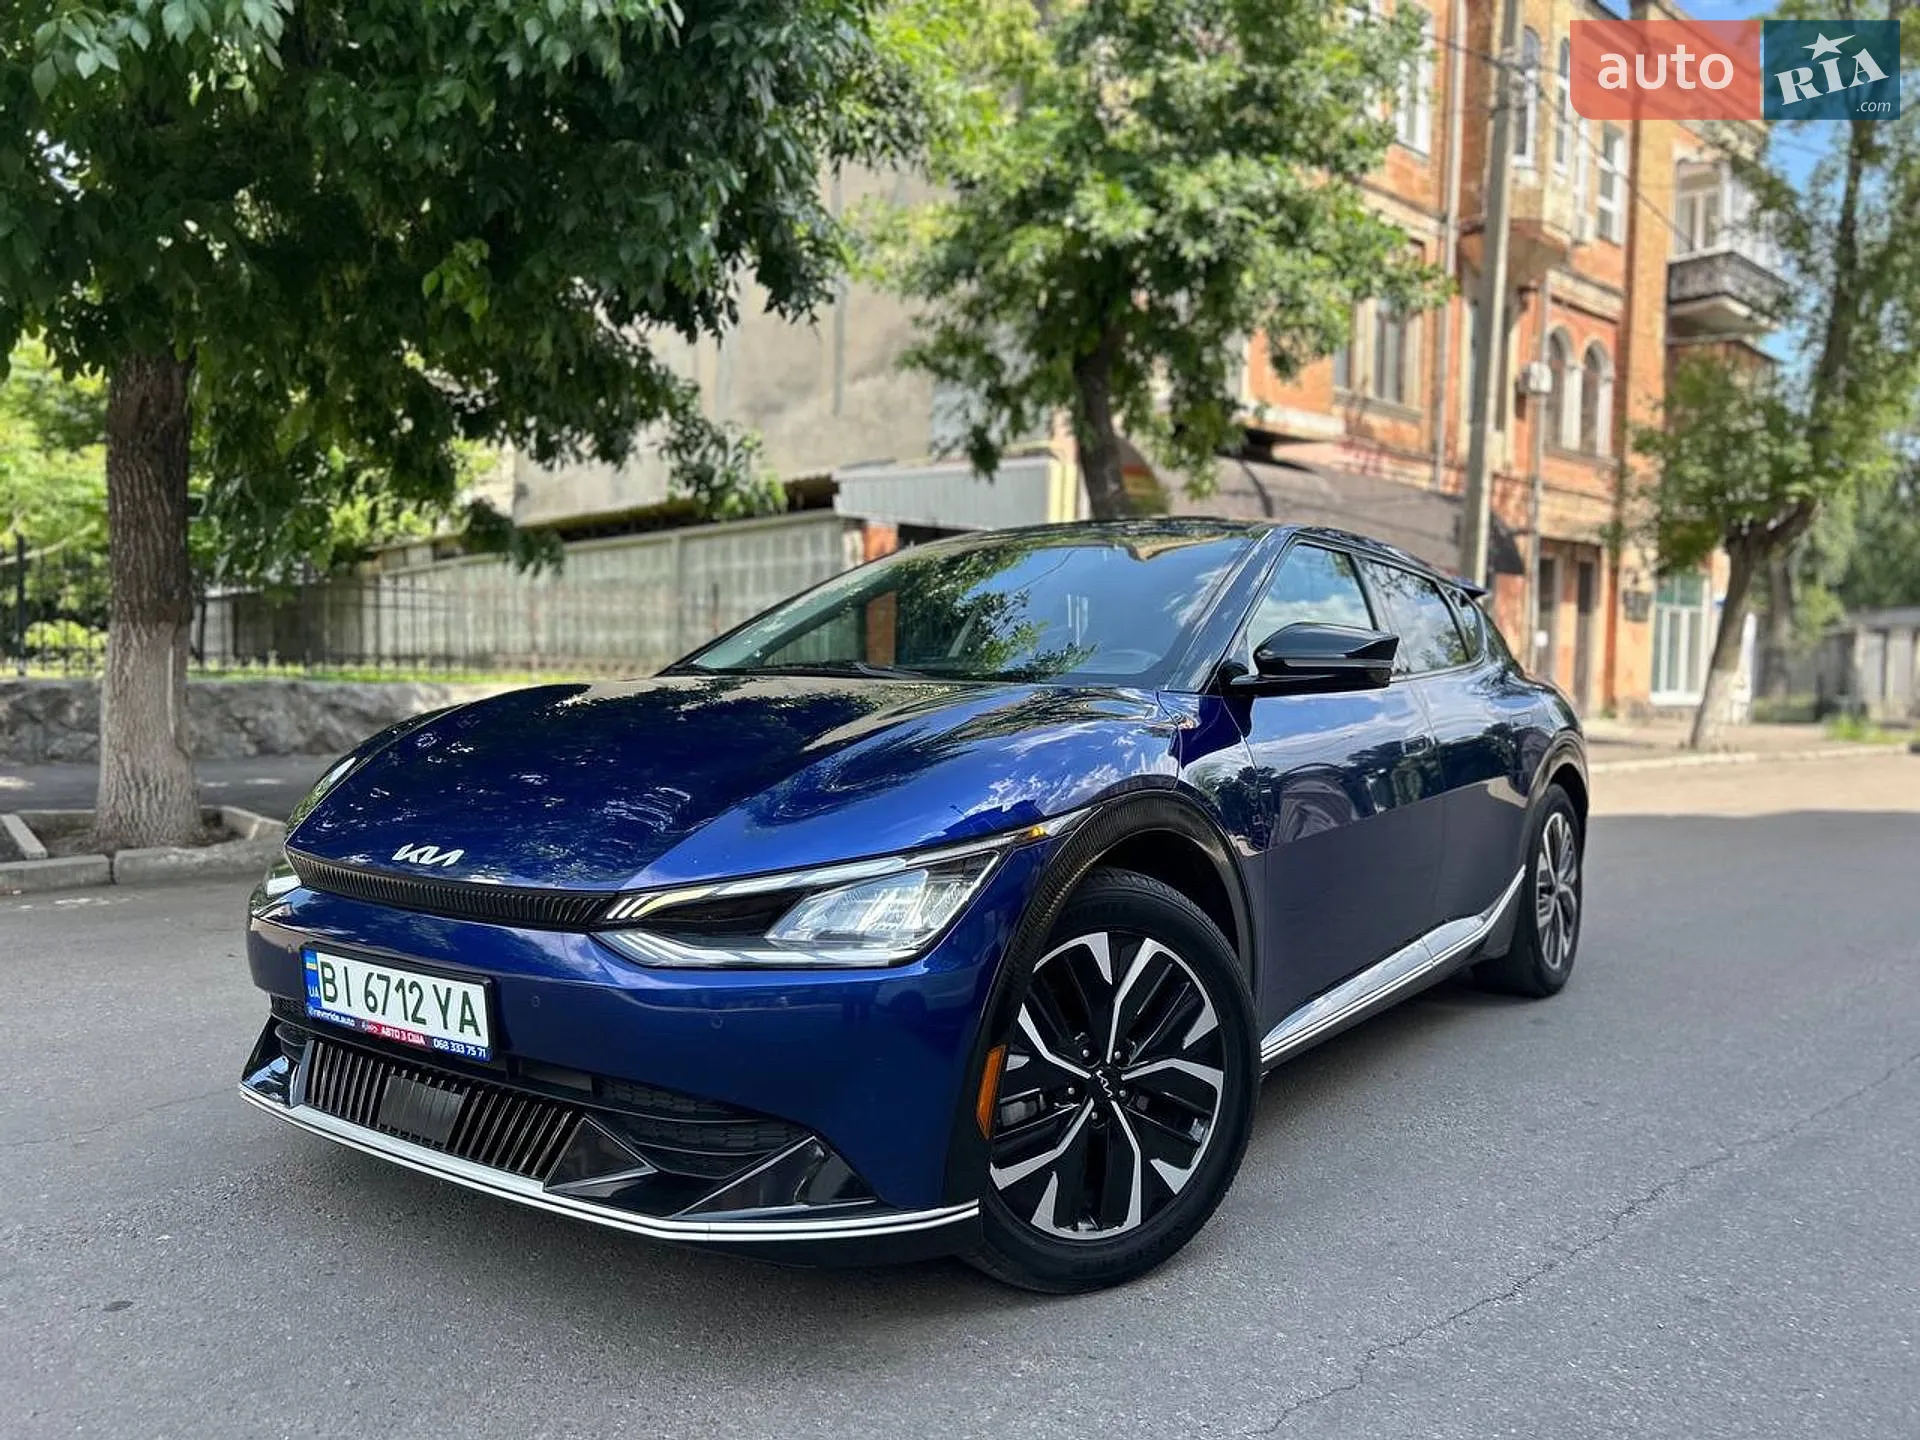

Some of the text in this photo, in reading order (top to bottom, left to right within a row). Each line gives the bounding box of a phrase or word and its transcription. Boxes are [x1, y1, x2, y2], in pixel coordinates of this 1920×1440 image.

[391, 843, 465, 867] KIA
[307, 984, 320, 998] UA
[364, 972, 427, 1025] 6712
[432, 984, 481, 1036] YA
